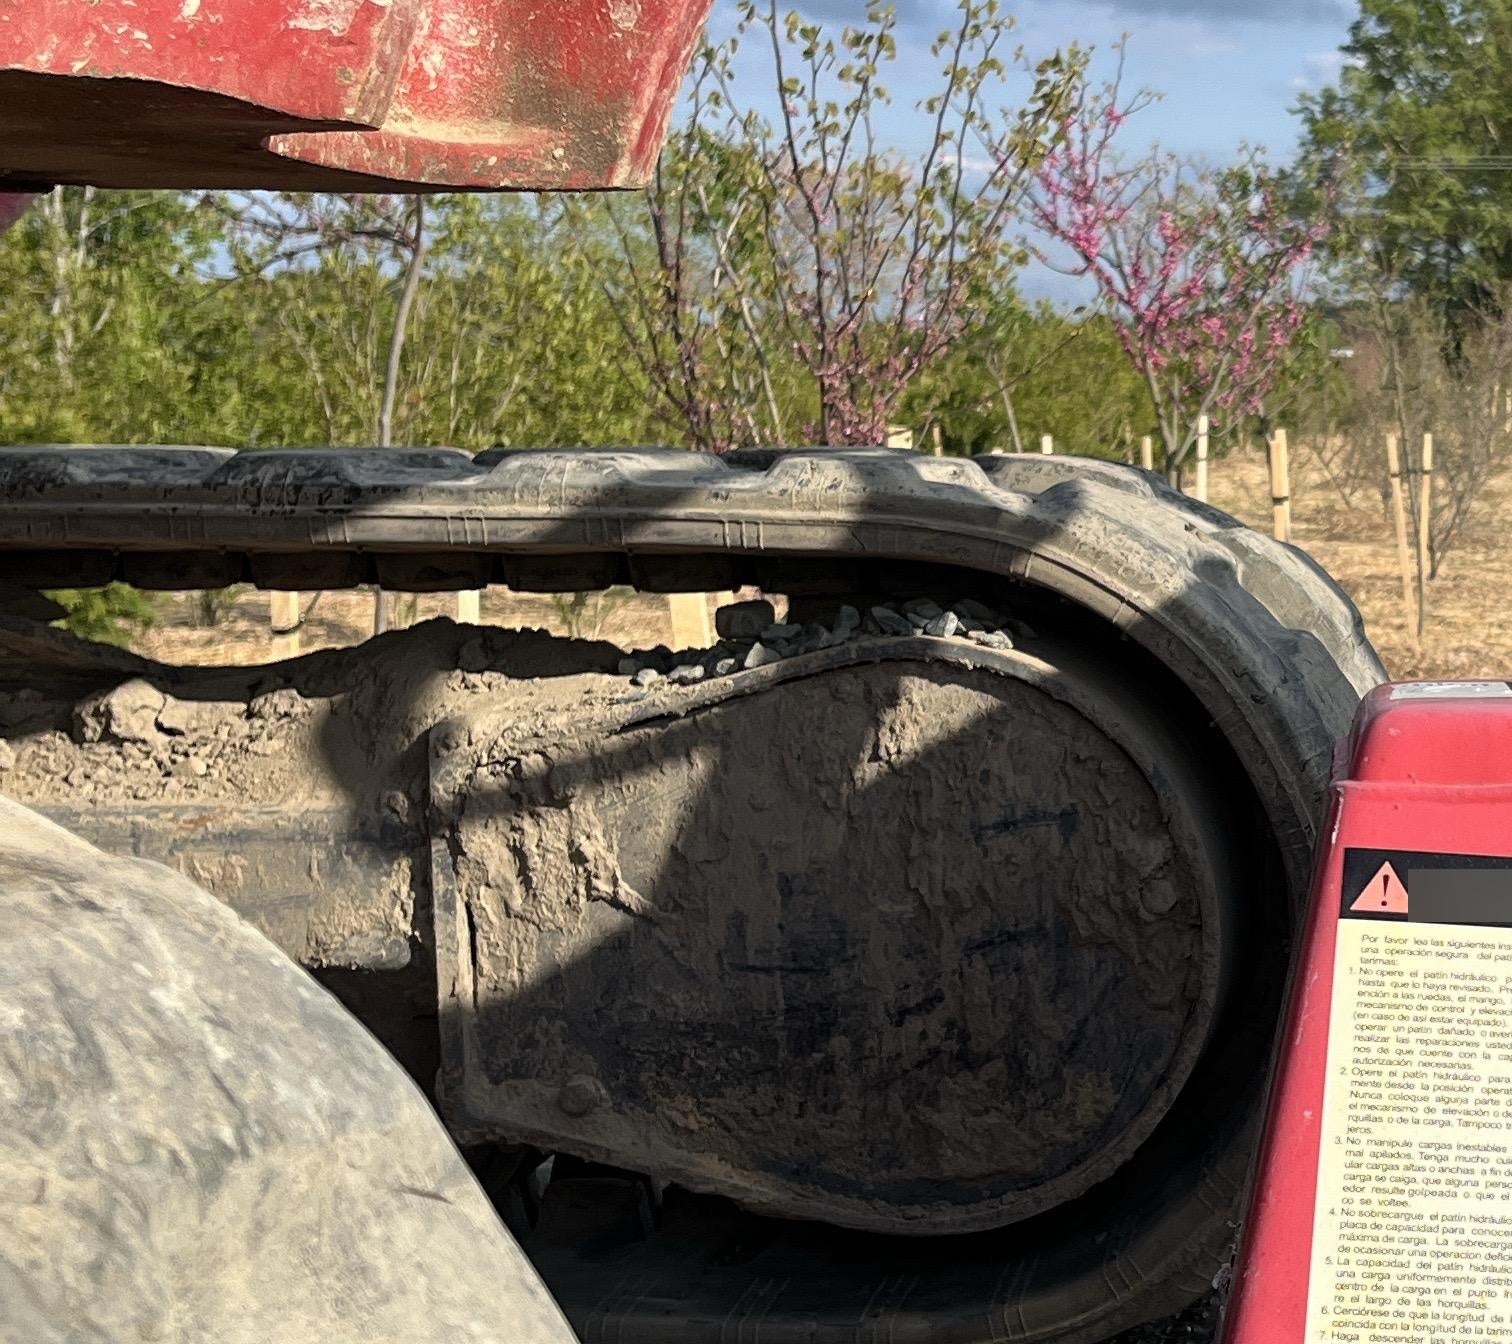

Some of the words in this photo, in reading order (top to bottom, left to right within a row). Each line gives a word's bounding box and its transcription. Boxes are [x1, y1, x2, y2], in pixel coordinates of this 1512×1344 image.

[1360, 934, 1379, 942] Por
[1383, 935, 1408, 944] favor
[1412, 937, 1428, 945] lea
[1430, 938, 1445, 946] las
[1357, 978, 1385, 986] hasta
[1389, 981, 1410, 990] que
[1410, 980, 1421, 988] lo
[1421, 981, 1447, 992] haya
[1350, 1067, 1383, 1078] Opere
[1387, 1068, 1398, 1077] el
[1487, 1076, 1511, 1085] para
[1348, 1089, 1383, 1099] Nunca
[1387, 1091, 1430, 1103] coloque
[1434, 1094, 1469, 1106] alguna
[1473, 1096, 1500, 1107] parte
[1347, 1113, 1384, 1124] rquillas
[1395, 1115, 1410, 1123] de
[1410, 1116, 1420, 1124] la
[1456, 1118, 1502, 1131] Tampoco
[1345, 1135, 1362, 1144] No
[1365, 1137, 1413, 1149] manipule
[1417, 1142, 1453, 1152] cargas
[1455, 1142, 1507, 1152] inestables
[1343, 1160, 1364, 1168] ular
[1364, 1163, 1400, 1172] cargas
[1402, 1162, 1427, 1172] altas
[1437, 1164, 1476, 1174] anchas
[1488, 1166, 1502, 1175] fin
[1338, 1219, 1368, 1231] placa
[1368, 1221, 1383, 1230] de
[1384, 1222, 1440, 1235] capacidad
[1440, 1226, 1465, 1236] para
[1337, 1243, 1351, 1252] de
[1352, 1244, 1404, 1255] ocasionar
[1335, 1270, 1356, 1278] una
[1360, 1271, 1391, 1281] carga
[1395, 1271, 1477, 1283] uniformemente
[1349, 1293, 1360, 1302] el
[1364, 1294, 1392, 1306] largo
[1396, 1296, 1411, 1305] de
[1415, 1297, 1432, 1306] las
[1331, 1318, 1376, 1329] coincida
[1378, 1322, 1398, 1330] con
[1399, 1321, 1410, 1330] la
[1412, 1322, 1456, 1335] longitud
[1458, 1324, 1472, 1334] de
[1473, 1325, 1484, 1334] la
